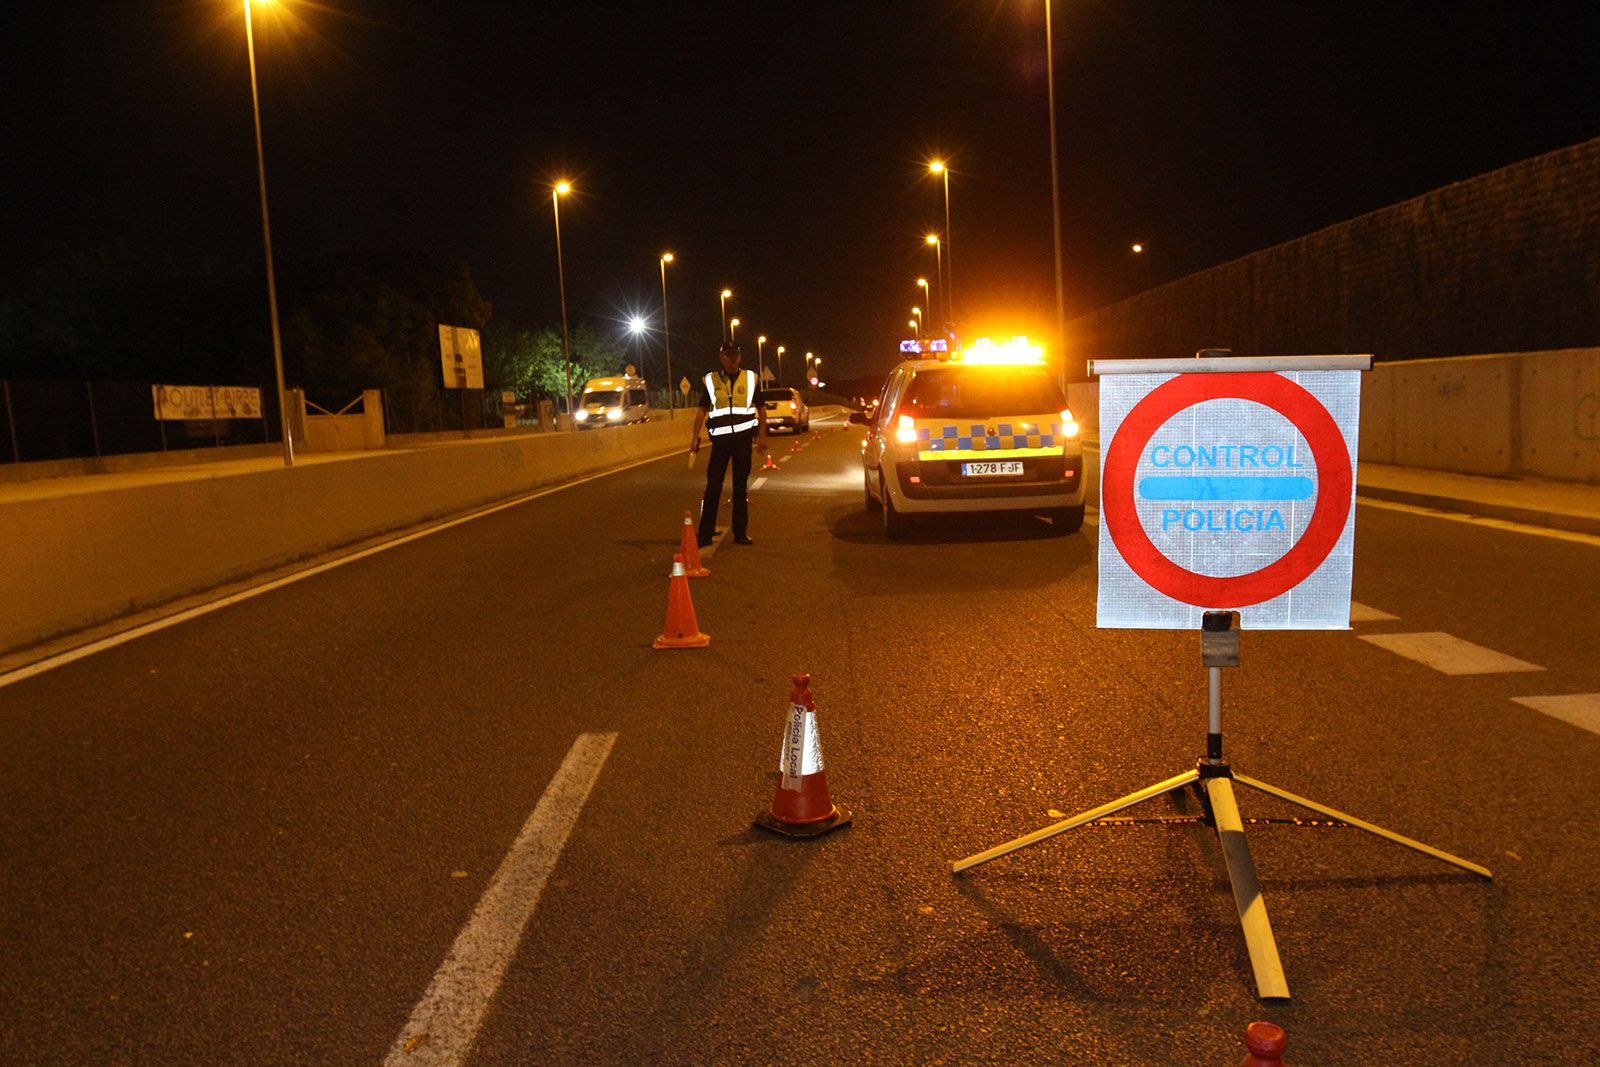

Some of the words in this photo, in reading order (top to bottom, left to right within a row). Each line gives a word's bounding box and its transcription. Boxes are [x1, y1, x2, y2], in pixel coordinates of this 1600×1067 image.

[1150, 445, 1303, 468] CONTROL
[1162, 509, 1286, 532] POLICIA
[789, 746, 800, 780] Local
